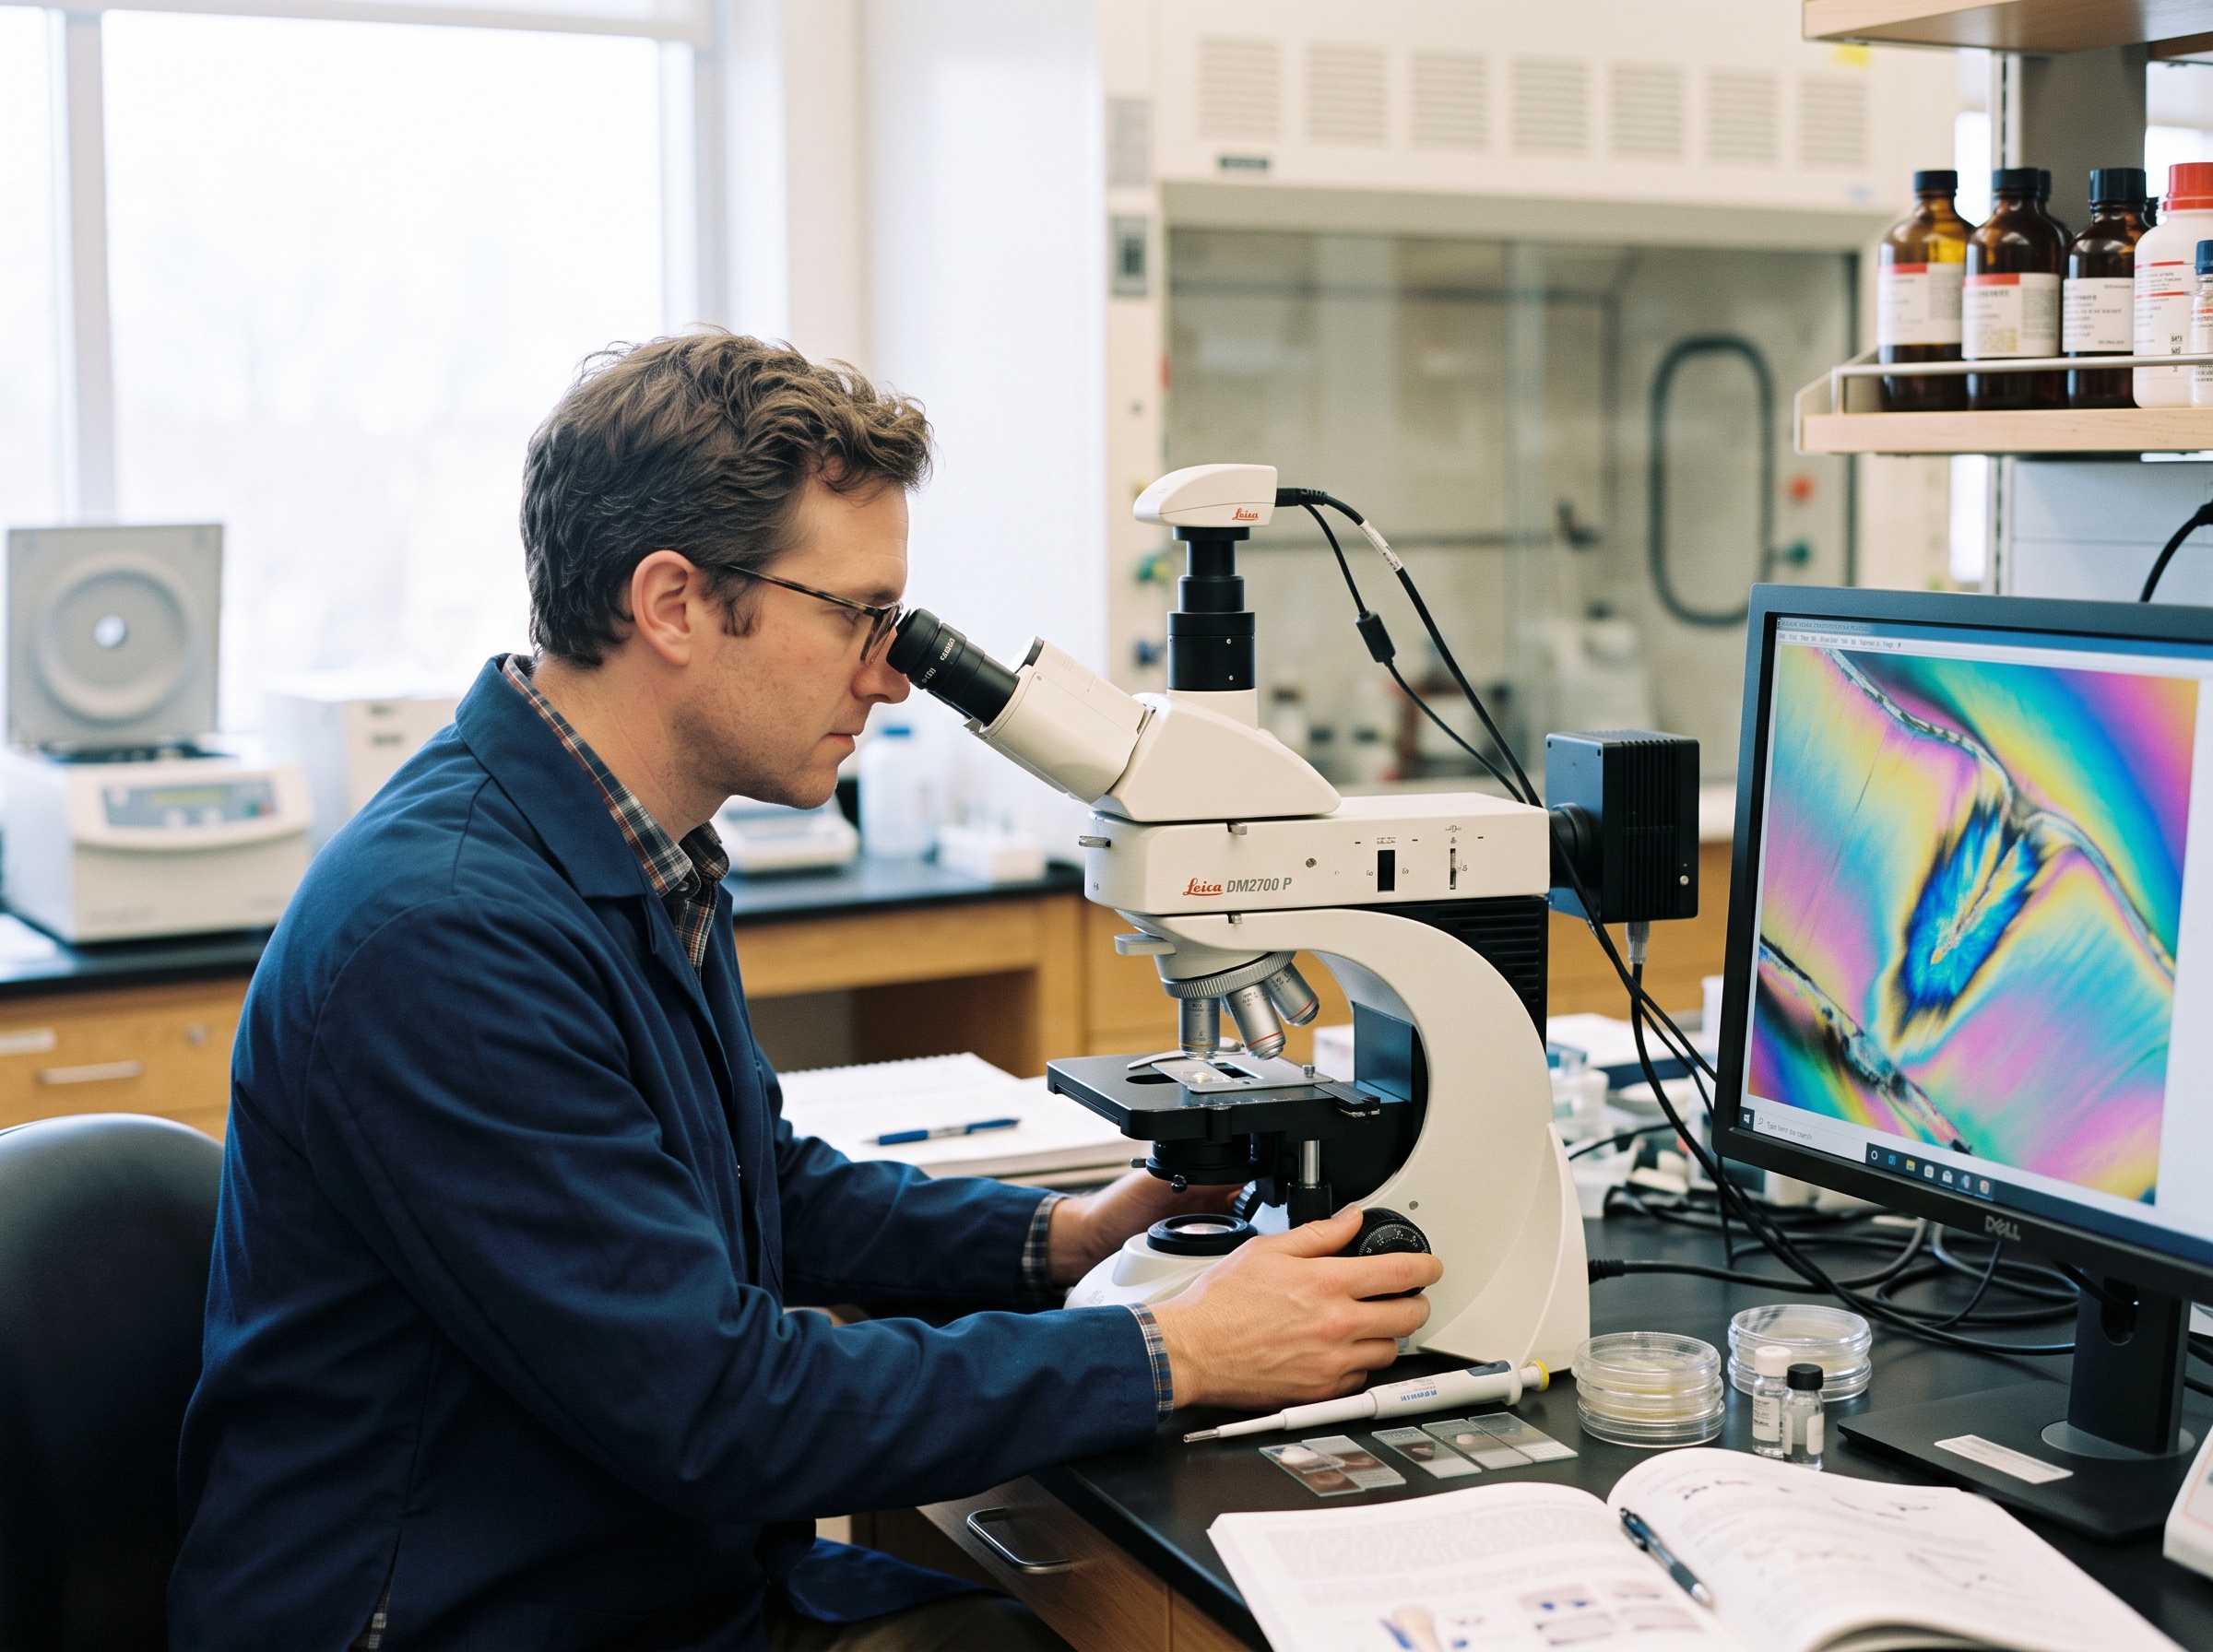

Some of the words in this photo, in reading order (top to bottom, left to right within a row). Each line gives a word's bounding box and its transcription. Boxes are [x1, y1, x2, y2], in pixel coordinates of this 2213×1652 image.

[1182, 878, 1224, 896] Leica
[1226, 878, 1280, 892] DM2700
[1283, 877, 1293, 891] P
[1984, 1214, 2021, 1242] DELL
